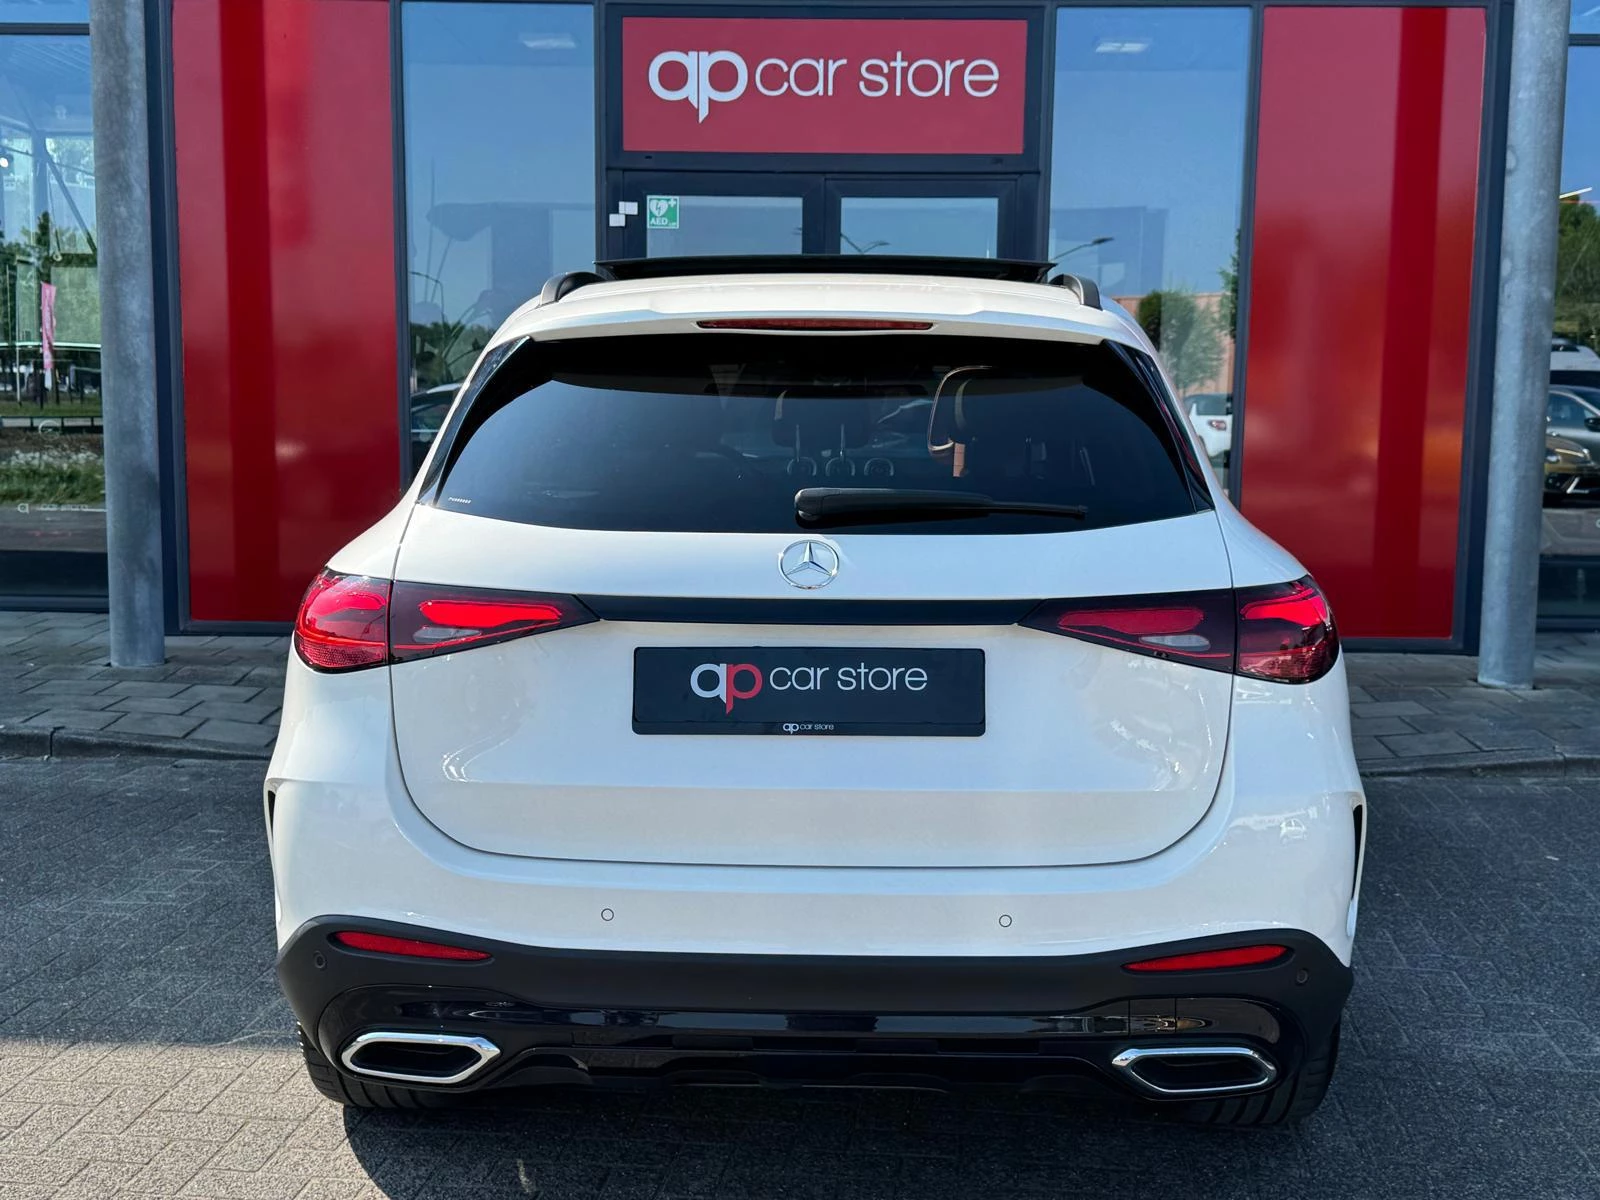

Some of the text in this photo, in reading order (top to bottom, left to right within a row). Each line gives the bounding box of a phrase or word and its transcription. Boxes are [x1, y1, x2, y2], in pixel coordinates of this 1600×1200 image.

[755, 58, 848, 97] car
[858, 50, 1000, 98] store
[650, 217, 669, 226] AED
[769, 666, 830, 691] car
[836, 661, 928, 691] store
[814, 723, 835, 731] store
